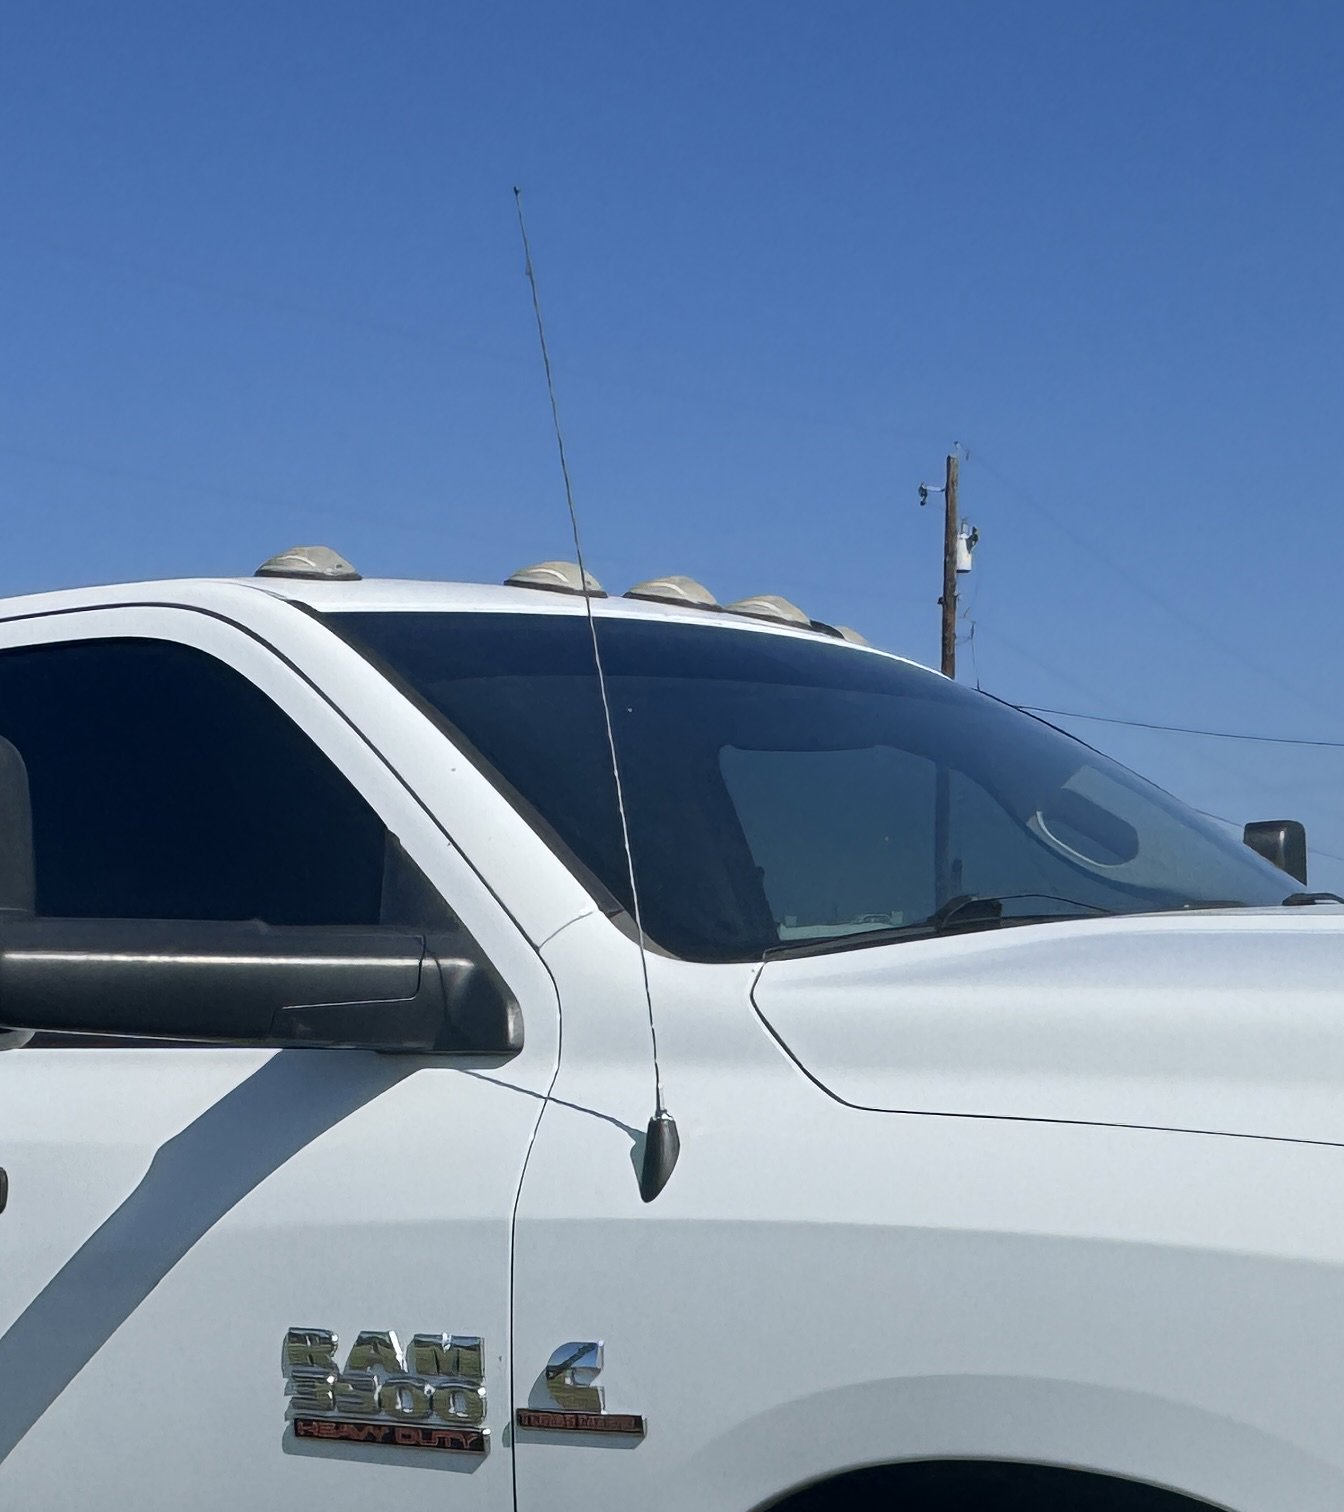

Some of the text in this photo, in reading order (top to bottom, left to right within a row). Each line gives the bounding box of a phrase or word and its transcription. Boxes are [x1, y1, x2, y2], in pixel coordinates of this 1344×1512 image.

[288, 1326, 485, 1377] RAM
[297, 1420, 478, 1449] HEAVY DUTY
